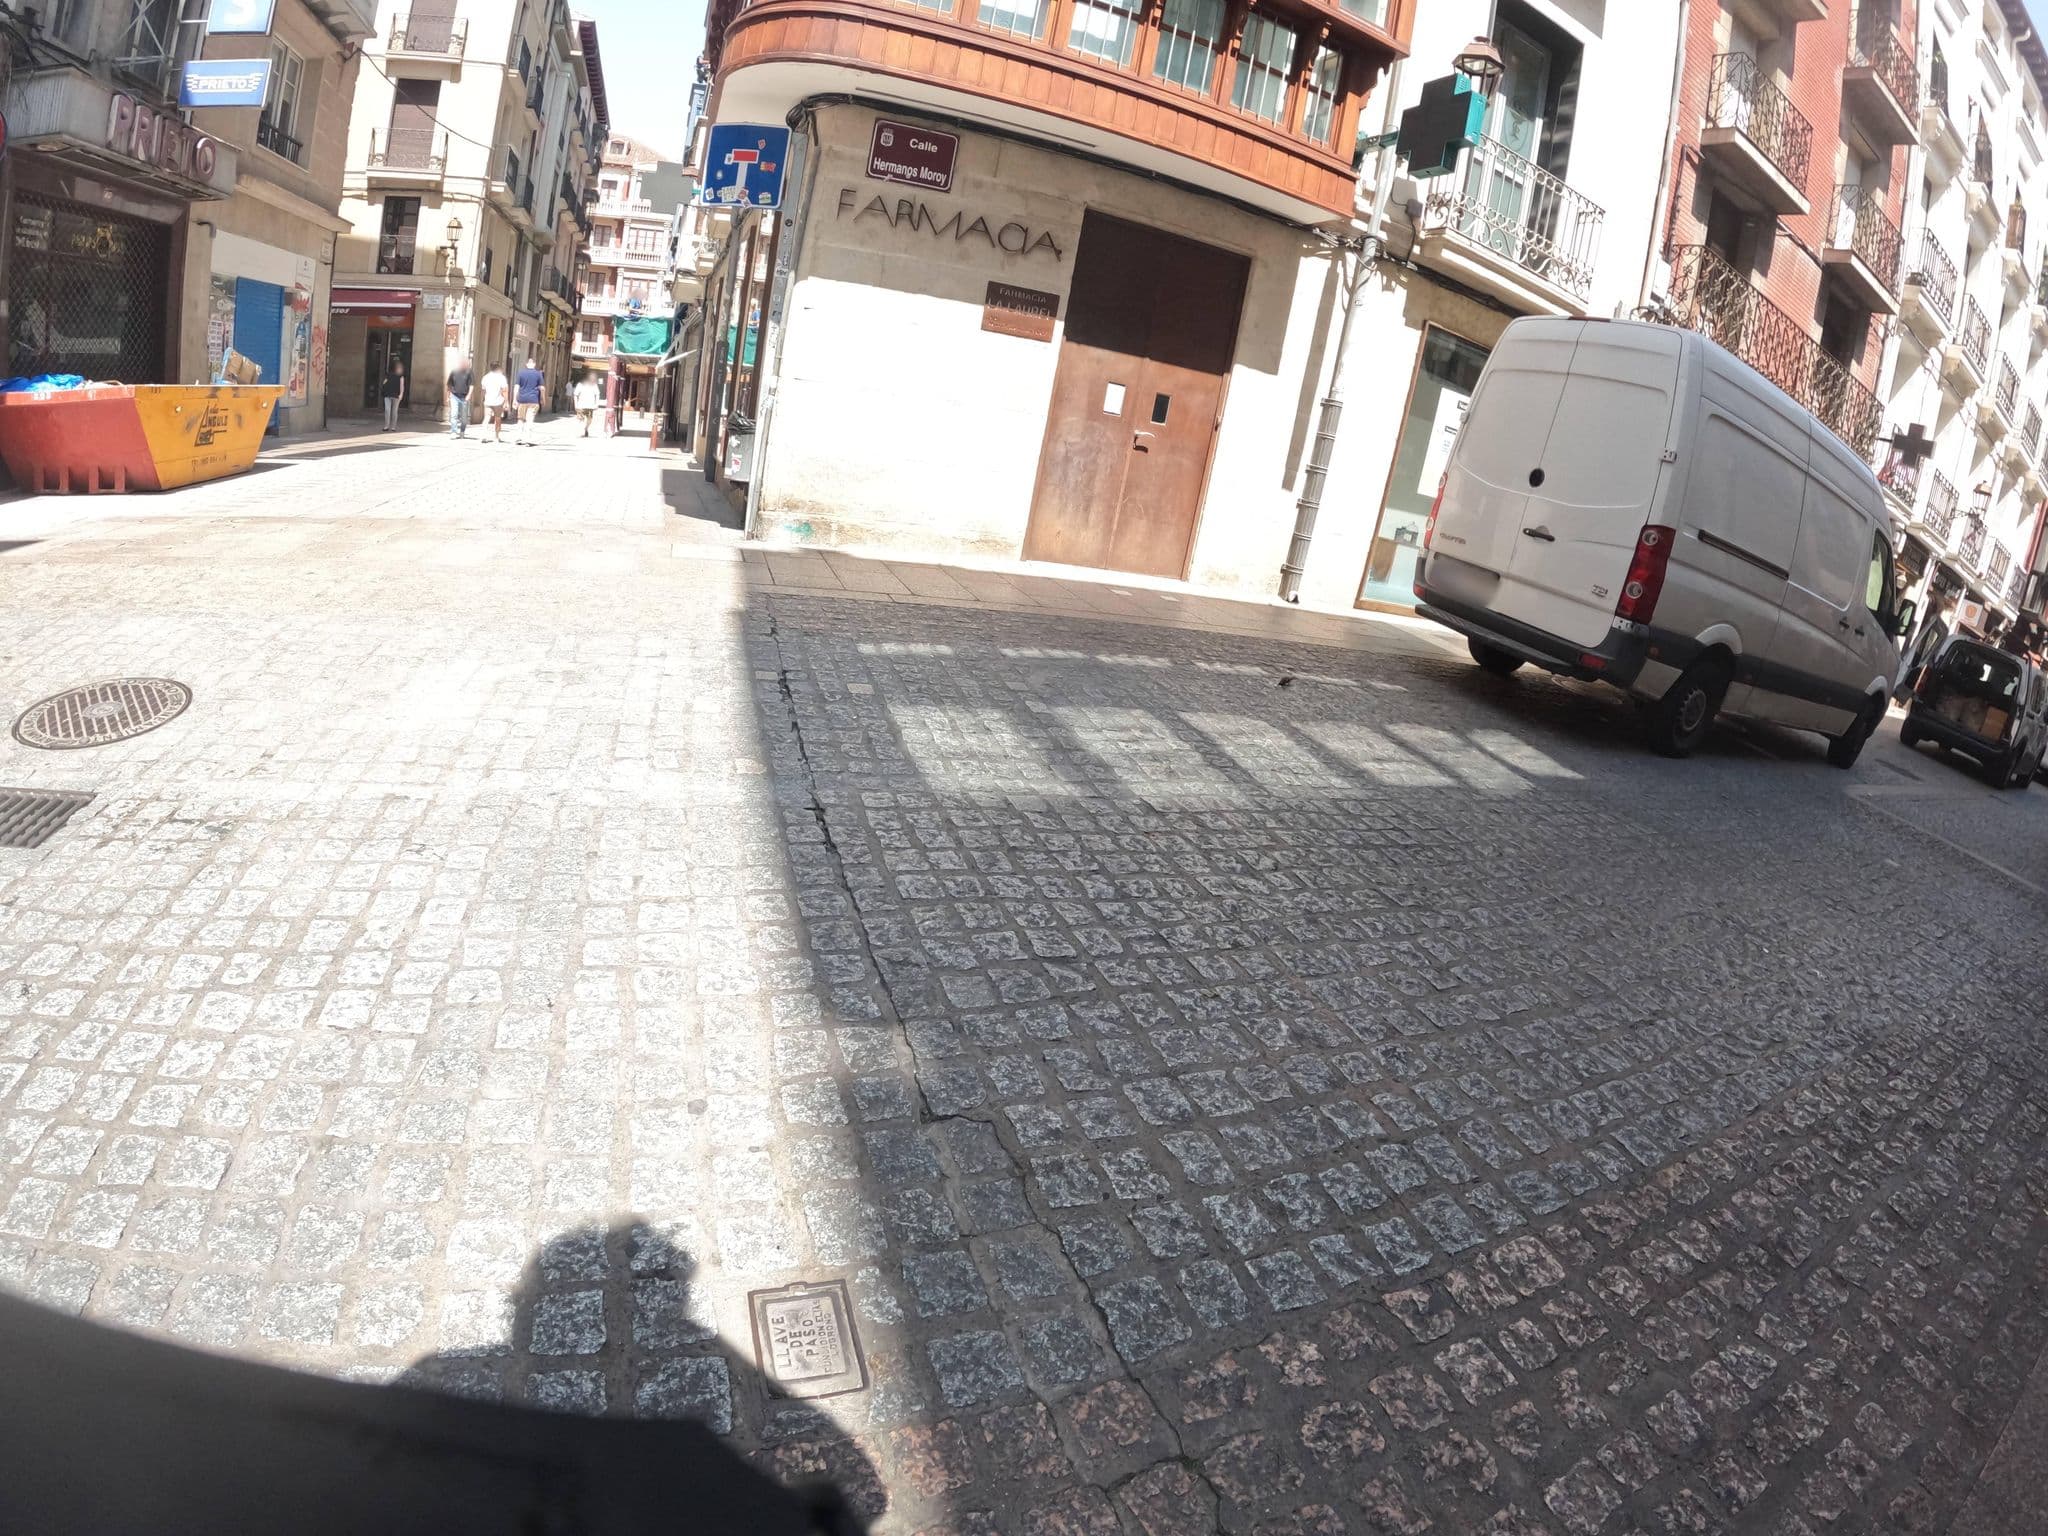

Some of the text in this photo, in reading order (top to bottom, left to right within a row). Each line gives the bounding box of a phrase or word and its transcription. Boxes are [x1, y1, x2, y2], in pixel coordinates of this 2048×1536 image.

[199, 79, 247, 90] PRIETO
[105, 93, 217, 182] PRIETO
[909, 138, 938, 153] Calle
[873, 156, 947, 186] Hermanos Moroy
[836, 188, 1062, 263] FARMACIA
[987, 298, 1003, 311] LA
[999, 287, 1047, 304] FARMACIA
[771, 1316, 792, 1368] LLAVE
[789, 1331, 803, 1348] DE
[802, 1319, 819, 1356] PASO
